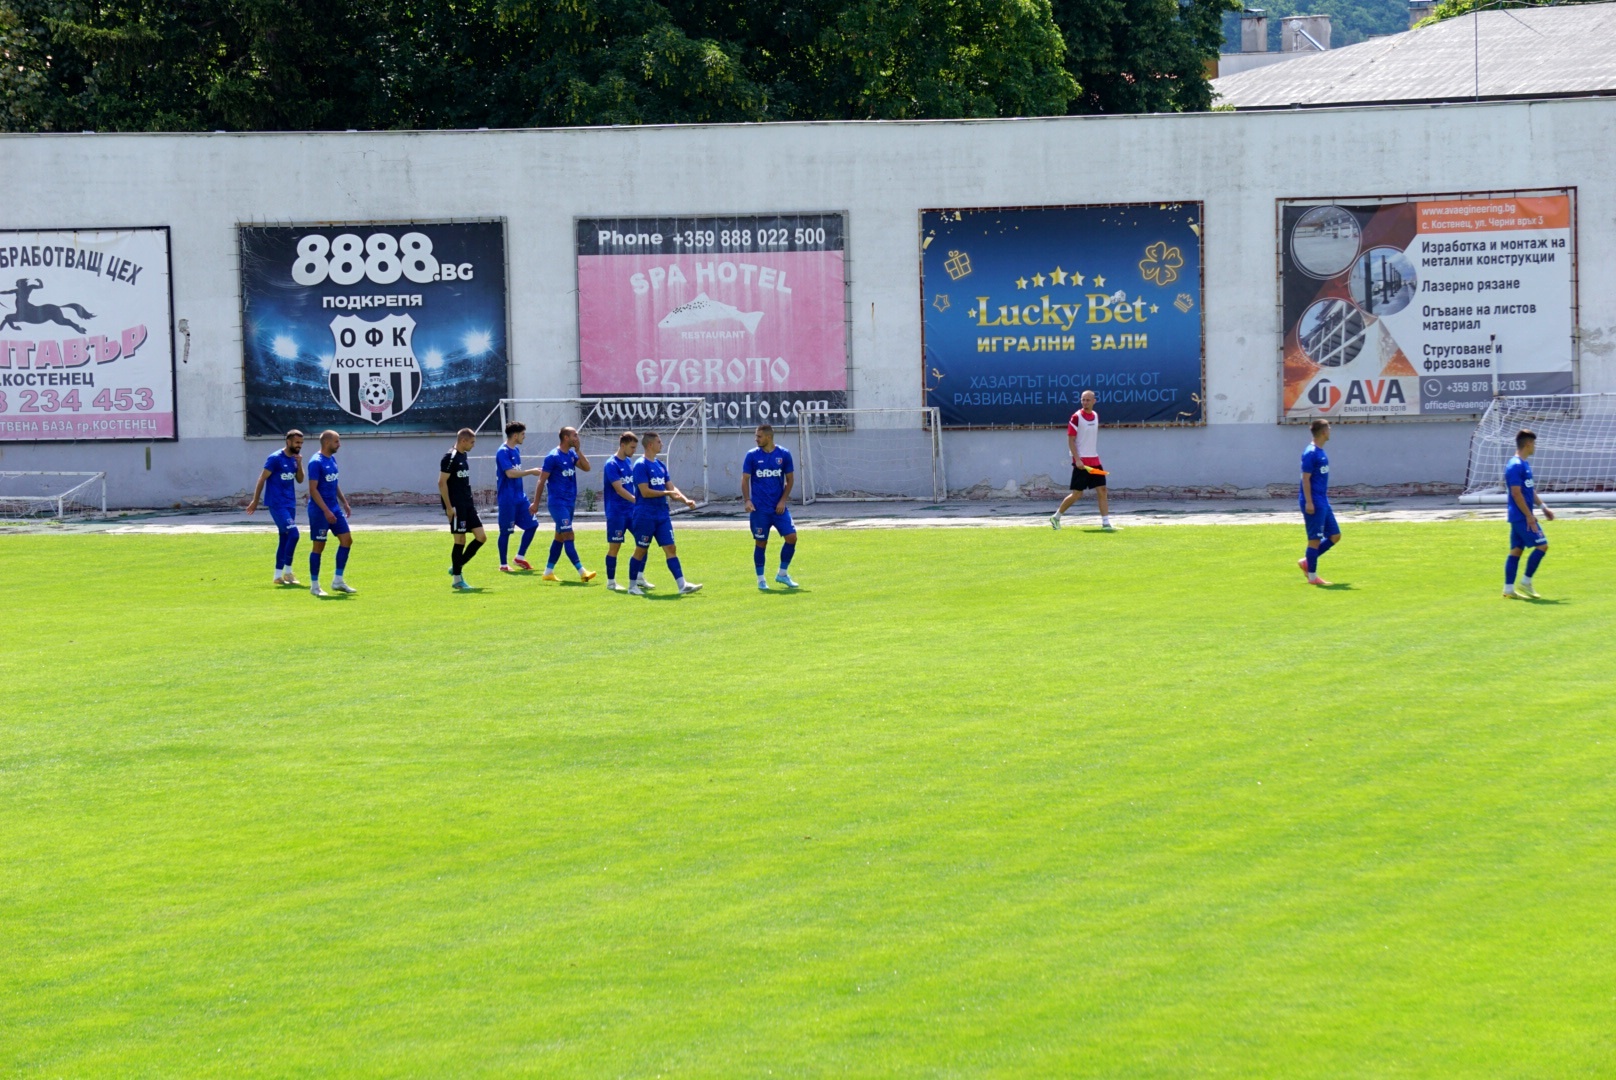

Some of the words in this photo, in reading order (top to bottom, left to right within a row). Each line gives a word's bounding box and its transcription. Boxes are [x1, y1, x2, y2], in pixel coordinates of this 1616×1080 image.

[1431, 219, 1473, 230] Костенец,
[1475, 221, 1487, 230] ул.
[1488, 217, 1515, 228] Черни
[1517, 217, 1537, 227] връх
[1538, 215, 1543, 225] 3
[599, 230, 663, 246] Phone
[673, 230, 715, 247] +359
[721, 229, 752, 247] 888
[757, 228, 789, 246] 022
[794, 228, 826, 245] 500
[1421, 240, 1487, 255] Изработка
[1489, 241, 1497, 250] и
[1500, 240, 1548, 250] монтаж
[1551, 238, 1566, 248] на
[1421, 256, 1473, 268] метални
[1476, 253, 1556, 268] конструкции
[106, 255, 143, 286] ЦЕХ
[629, 264, 687, 295] SPA
[695, 261, 792, 294] HOTEL
[1421, 280, 1474, 294] Лазерно
[1477, 279, 1520, 293] рязане
[322, 294, 423, 310] ПОДКРЕПЯ
[975, 295, 1082, 331] Lucky
[1085, 293, 1148, 325] Bet
[1422, 304, 1474, 317] Огъване
[1476, 306, 1491, 315] на
[1494, 303, 1537, 315] листов
[1422, 319, 1481, 333] материал
[681, 330, 746, 339] RESTAURANT
[977, 335, 1075, 353] ИГРАЛНИ
[1090, 333, 1148, 350] ЗАЛИ
[1422, 343, 1491, 358] Струговане
[1495, 344, 1503, 353] и
[336, 357, 414, 369] КОСТЕНЕЦ
[1423, 357, 1491, 372] фрезоване
[970, 375, 1044, 389] ХАЗАРТЪТ
[1048, 373, 1091, 388] НОСИ
[1096, 373, 1135, 387] РИСК
[1140, 372, 1160, 385] ОТ
[1446, 382, 1469, 393] +359
[1471, 381, 1489, 392] 878
[1491, 381, 1507, 391] 02
[1508, 380, 1527, 391] 033
[954, 391, 1043, 406] РАЗВИВАНЕ
[1047, 391, 1069, 404] НА
[1072, 388, 1178, 404] ЗВИСИМОСТ
[1344, 379, 1406, 404] AVA
[19, 388, 82, 412] 234
[92, 387, 155, 412] 453
[42, 421, 73, 431] БАЗА
[77, 419, 157, 432] гр.КОСТЕНЕЦ
[755, 469, 782, 478] efbet
